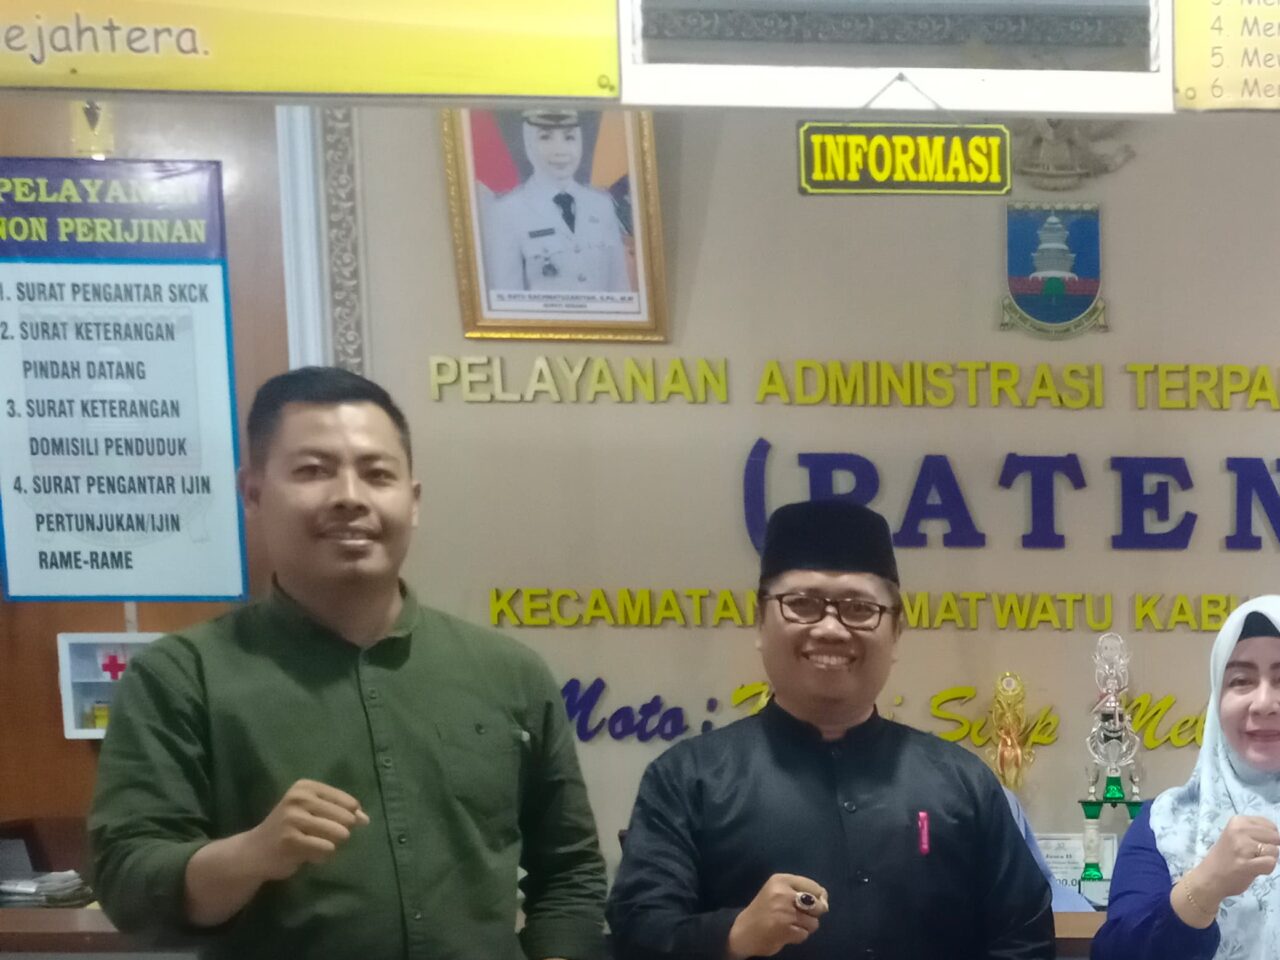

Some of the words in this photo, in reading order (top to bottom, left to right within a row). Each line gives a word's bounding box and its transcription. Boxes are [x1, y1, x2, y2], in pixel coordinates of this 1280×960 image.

[810, 133, 1002, 185] INFORMASI
[57, 217, 207, 243] PERIJINAN
[17, 282, 66, 302] SURAT
[72, 283, 163, 303] PENGANTAR
[168, 284, 210, 303] SKCK
[20, 321, 69, 341] SURAT
[75, 322, 176, 342] KETERANGAN
[22, 360, 81, 380] PINDAH
[87, 361, 147, 380] DATANG
[429, 355, 730, 404] PELAYANAN
[754, 359, 1105, 411] ADMINISTRASI
[6, 399, 21, 419] 3.
[26, 399, 75, 419] SURAT
[81, 399, 181, 419] KETERANGAN
[29, 437, 100, 456] DOMISILI
[105, 437, 188, 456] PENDUDUK
[13, 475, 28, 494] 4.
[33, 475, 82, 494] SURAT
[87, 475, 177, 494] PENGANTAR
[181, 475, 211, 495] IJIN
[35, 513, 181, 534] PERTUNJUKAN/IJIN
[38, 551, 134, 570] RAME-RAME
[900, 590, 1114, 632] MATWATU
